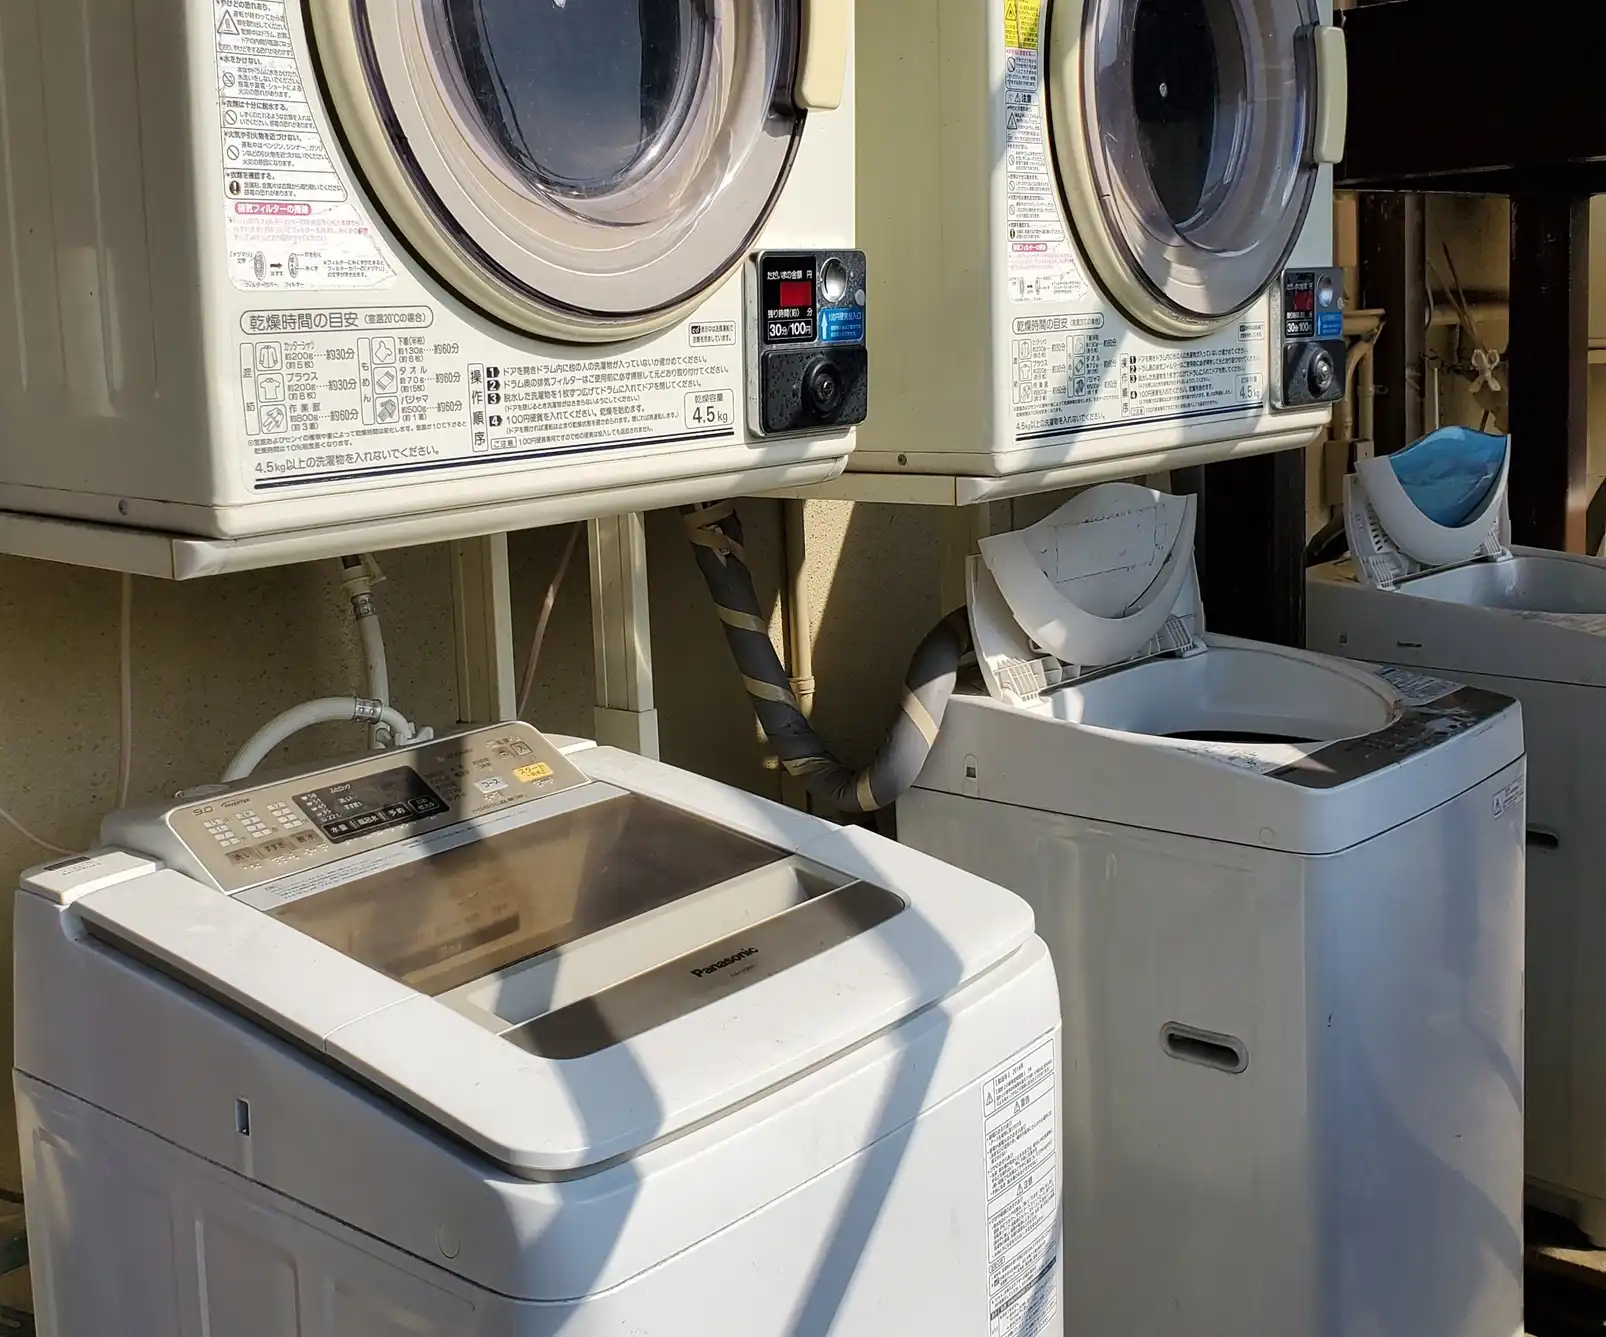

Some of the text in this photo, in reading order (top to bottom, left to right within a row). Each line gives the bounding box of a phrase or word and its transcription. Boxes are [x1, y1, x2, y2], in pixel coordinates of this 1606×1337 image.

[249, 312, 359, 332] 乾燥時間の目安
[326, 348, 355, 360] 約30分
[434, 343, 459, 354] 約60分
[286, 372, 318, 382] ブラウス
[435, 372, 461, 384] 約60分
[328, 378, 357, 391] 約30分
[401, 395, 429, 405] パジャマ
[694, 393, 724, 404] 乾燥容量
[437, 400, 462, 412] 約60分
[330, 409, 359, 421] 約60分
[692, 405, 728, 424] 4.5 kg
[690, 946, 759, 978] Panasonic
